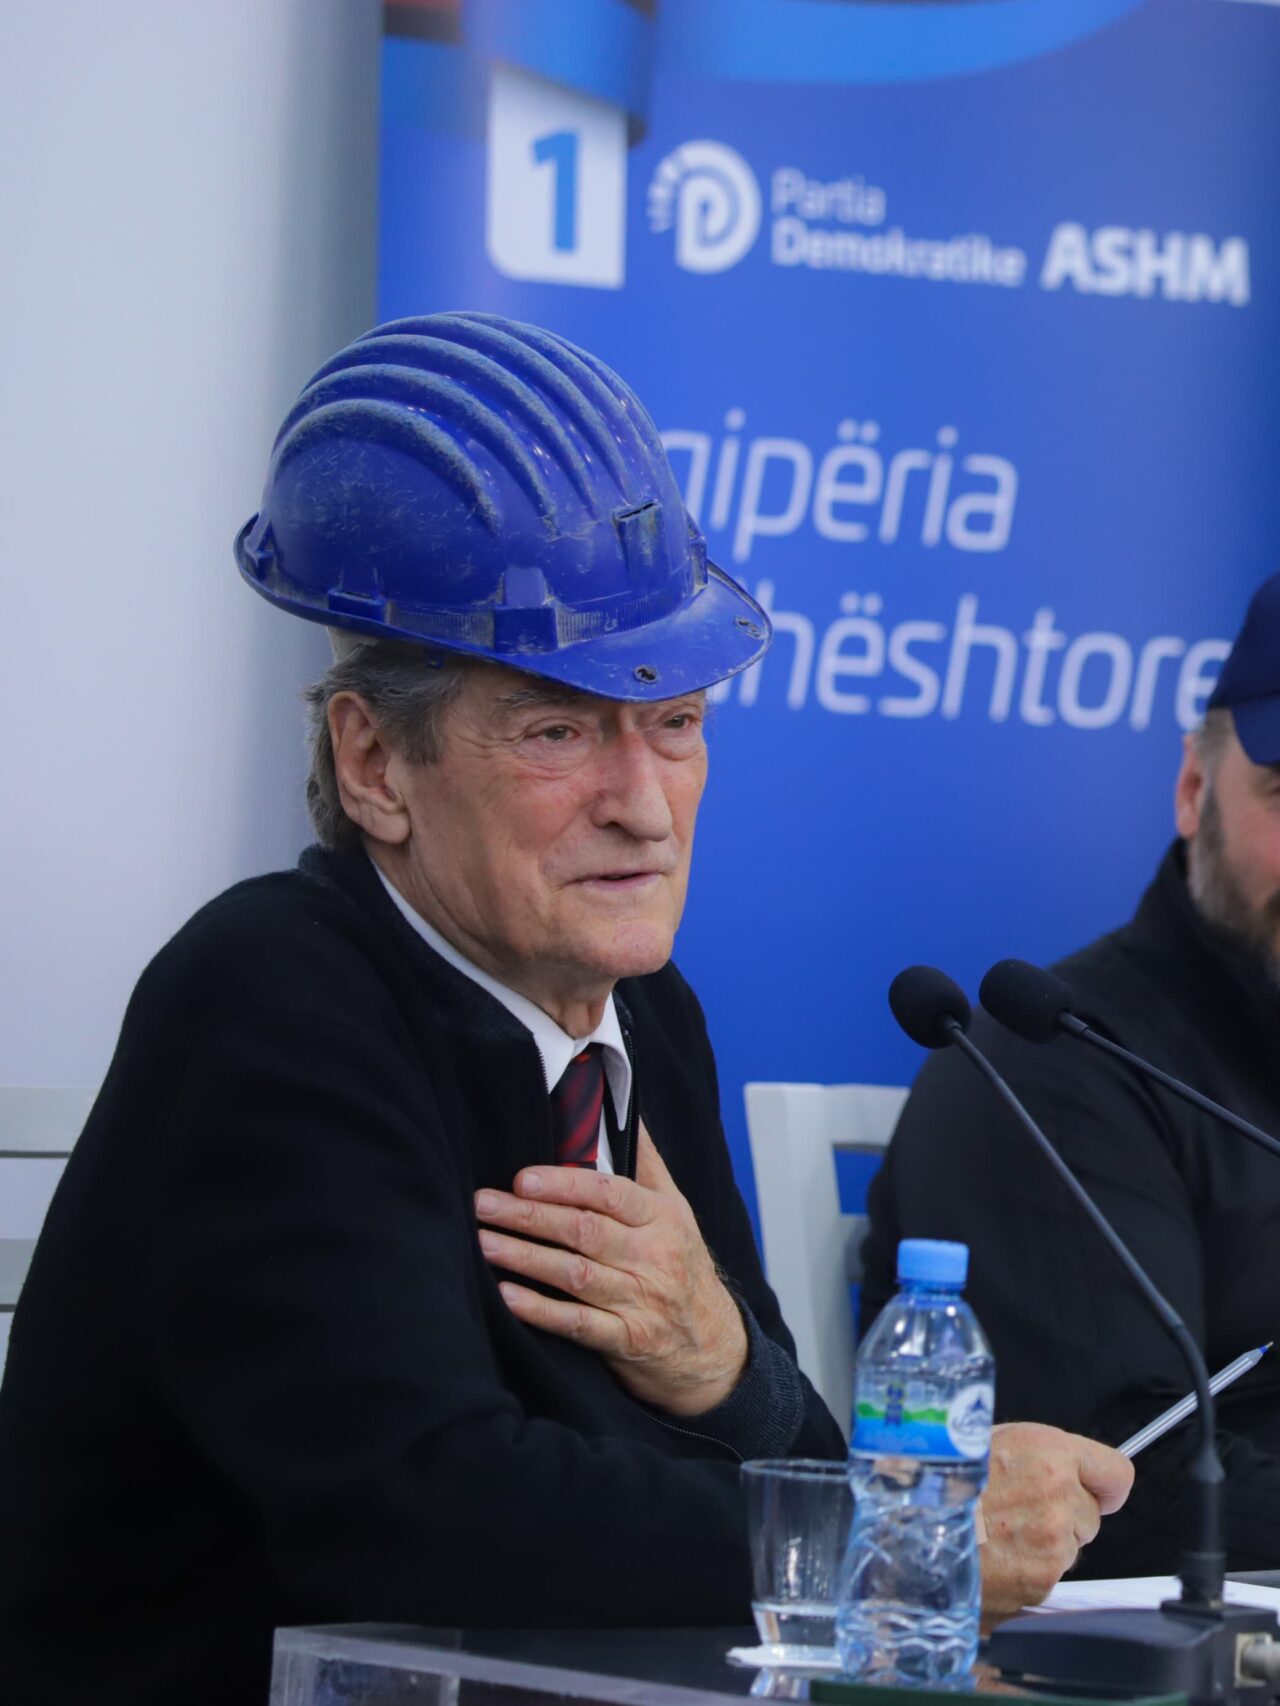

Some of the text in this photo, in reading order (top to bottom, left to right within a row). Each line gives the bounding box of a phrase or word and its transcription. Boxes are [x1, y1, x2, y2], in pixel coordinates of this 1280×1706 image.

[531, 130, 580, 253] 1
[772, 168, 887, 226] Partia
[771, 217, 1027, 288] Demokratike
[1040, 222, 1251, 306] ASHM
[706, 577, 1233, 732] hështore
